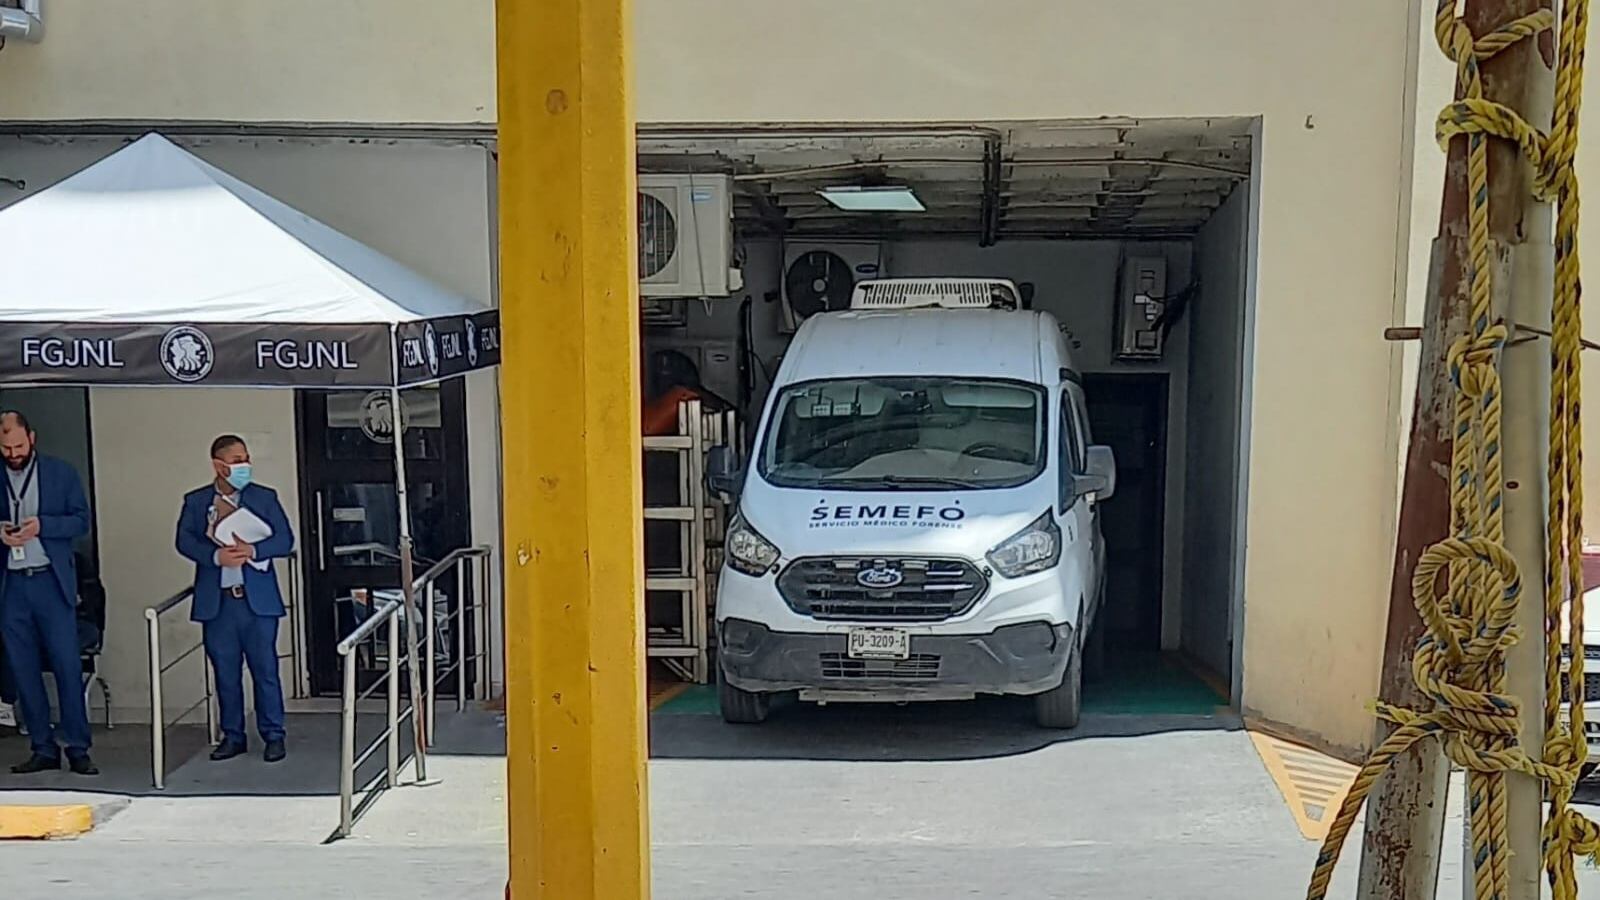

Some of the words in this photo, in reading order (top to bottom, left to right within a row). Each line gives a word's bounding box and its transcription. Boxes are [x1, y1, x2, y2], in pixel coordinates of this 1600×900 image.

[22, 339, 124, 367] FGJNL
[256, 341, 358, 369] FGJNL
[811, 505, 965, 521] SEMEFO
[809, 520, 859, 529] SERVICIO
